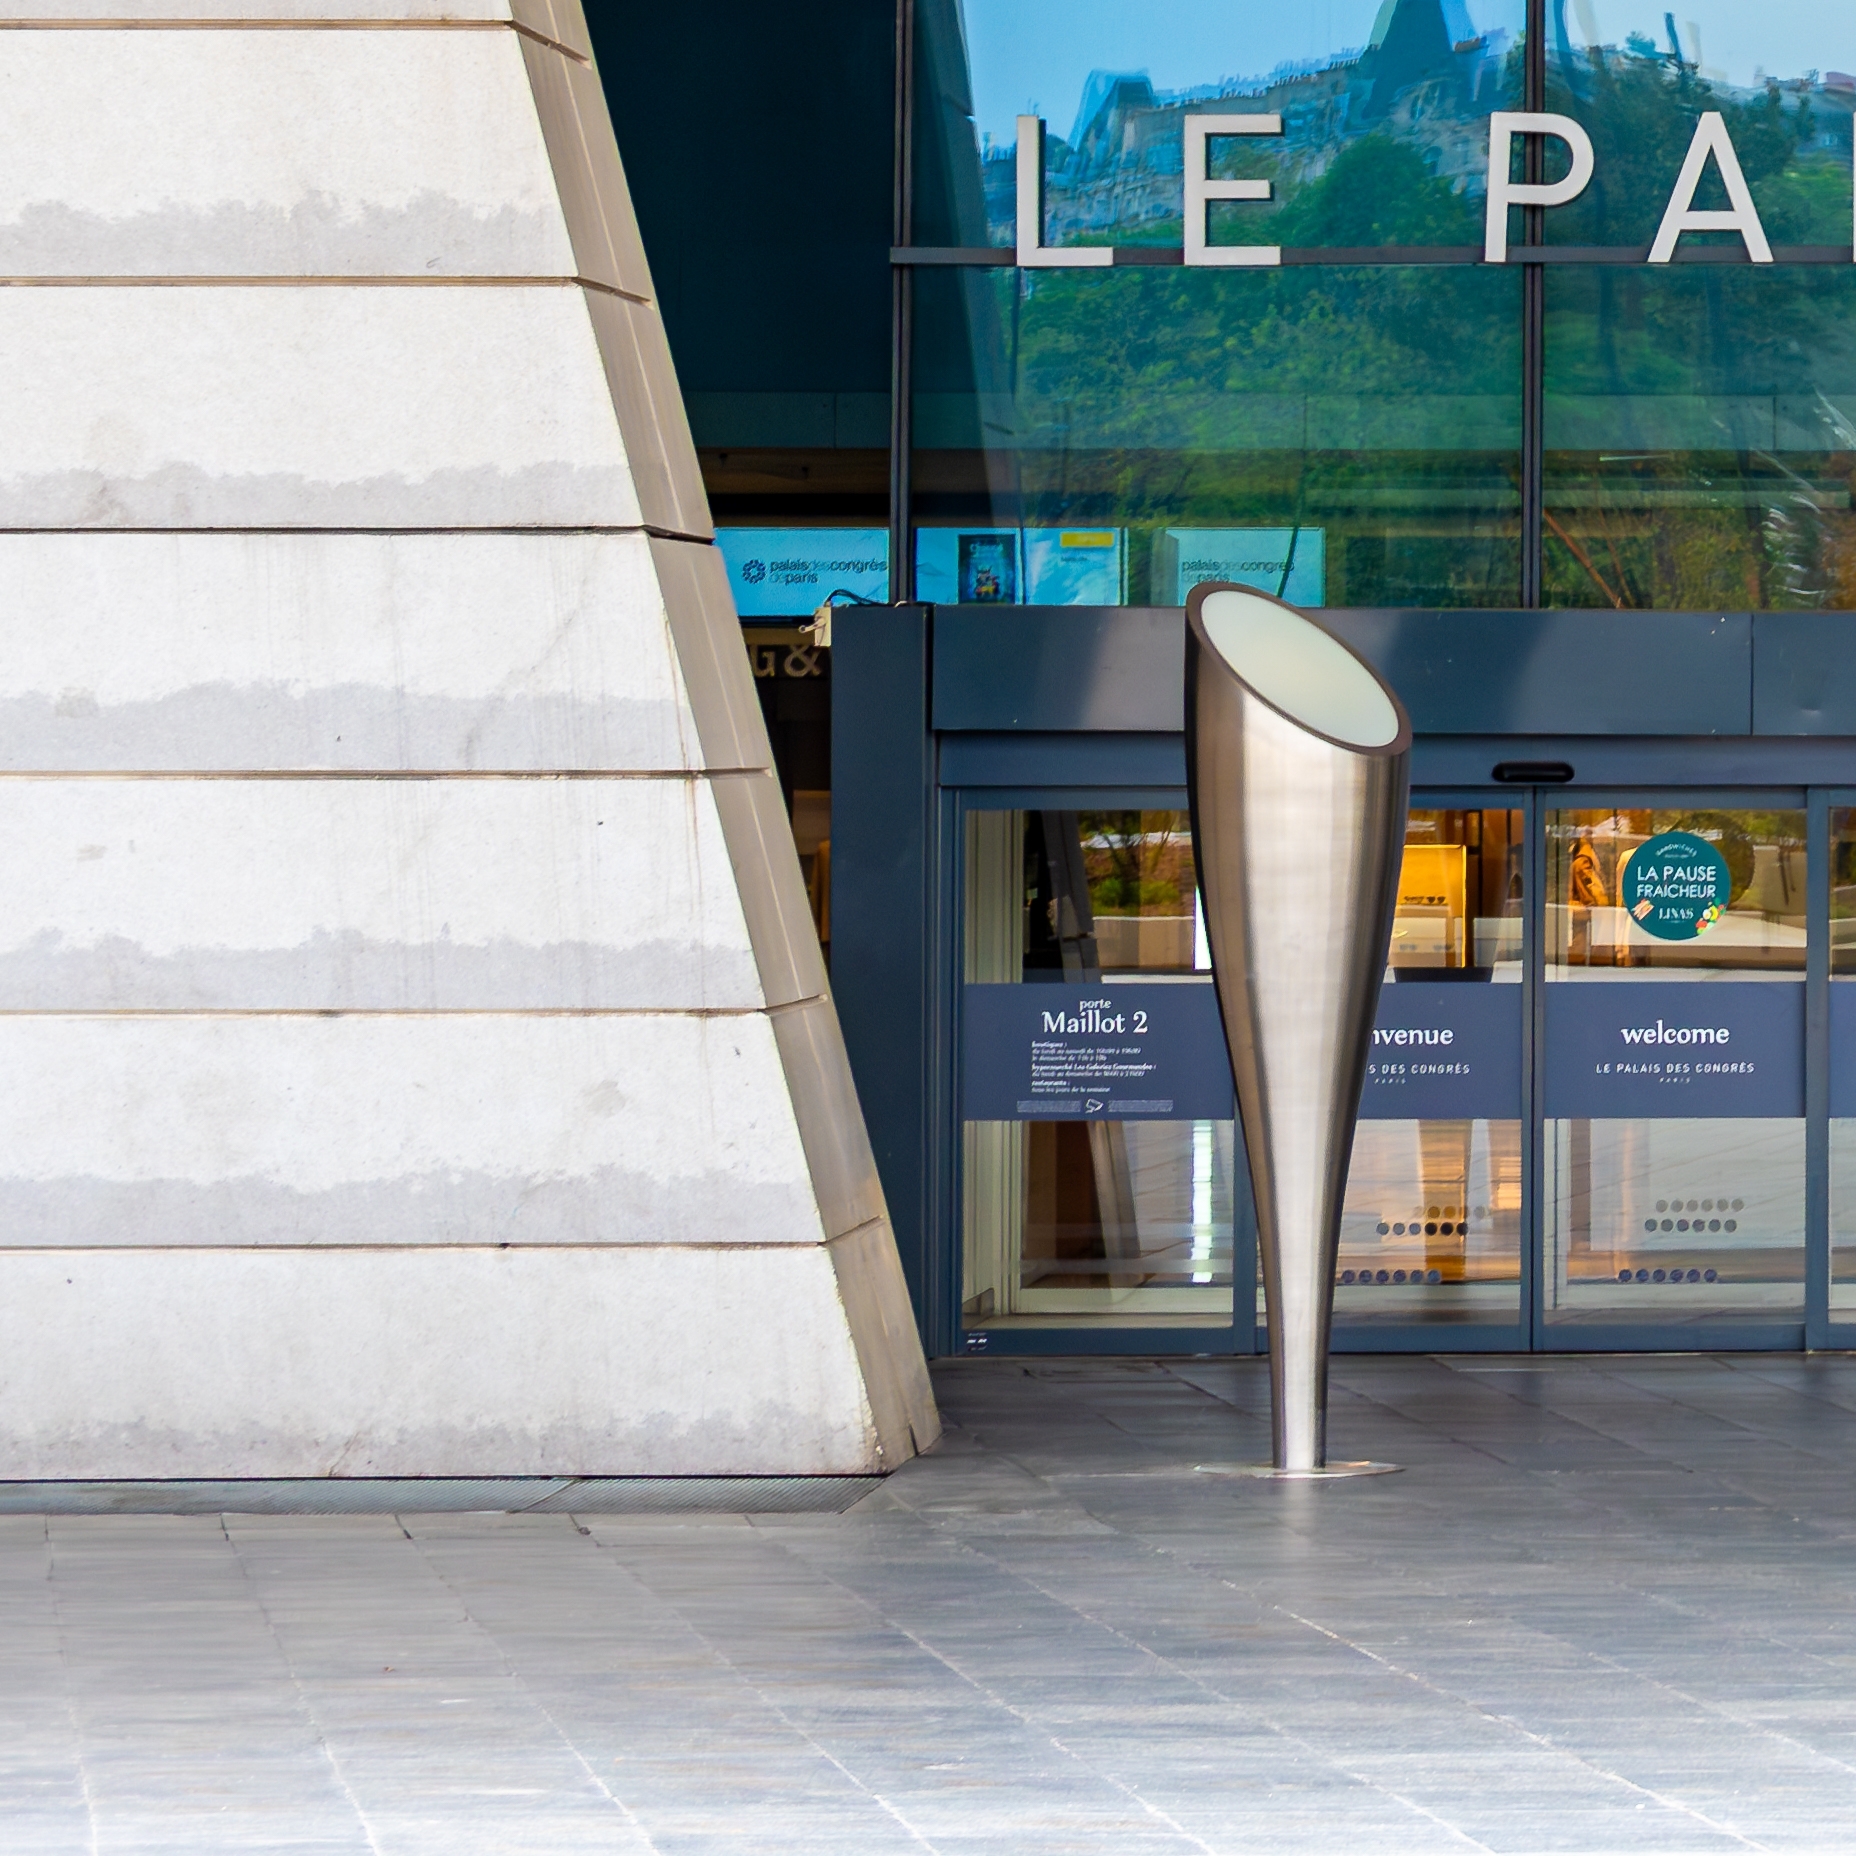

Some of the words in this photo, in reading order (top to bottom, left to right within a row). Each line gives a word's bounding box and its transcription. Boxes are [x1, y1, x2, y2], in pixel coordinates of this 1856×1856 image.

[1015, 113, 1283, 269] LE
[1637, 865, 1659, 882] LA
[1663, 865, 1717, 882] PAUSE
[1080, 998, 1112, 1012] porte
[1042, 1009, 1127, 1034] Maillot
[1132, 1010, 1149, 1034] 2
[1372, 1028, 1454, 1045] nvenue
[1620, 1019, 1730, 1045] welcome
[1381, 1063, 1406, 1074] DES
[1595, 1063, 1611, 1074] LE
[1616, 1063, 1661, 1074] PALAIS
[1666, 1063, 1691, 1074] DES
